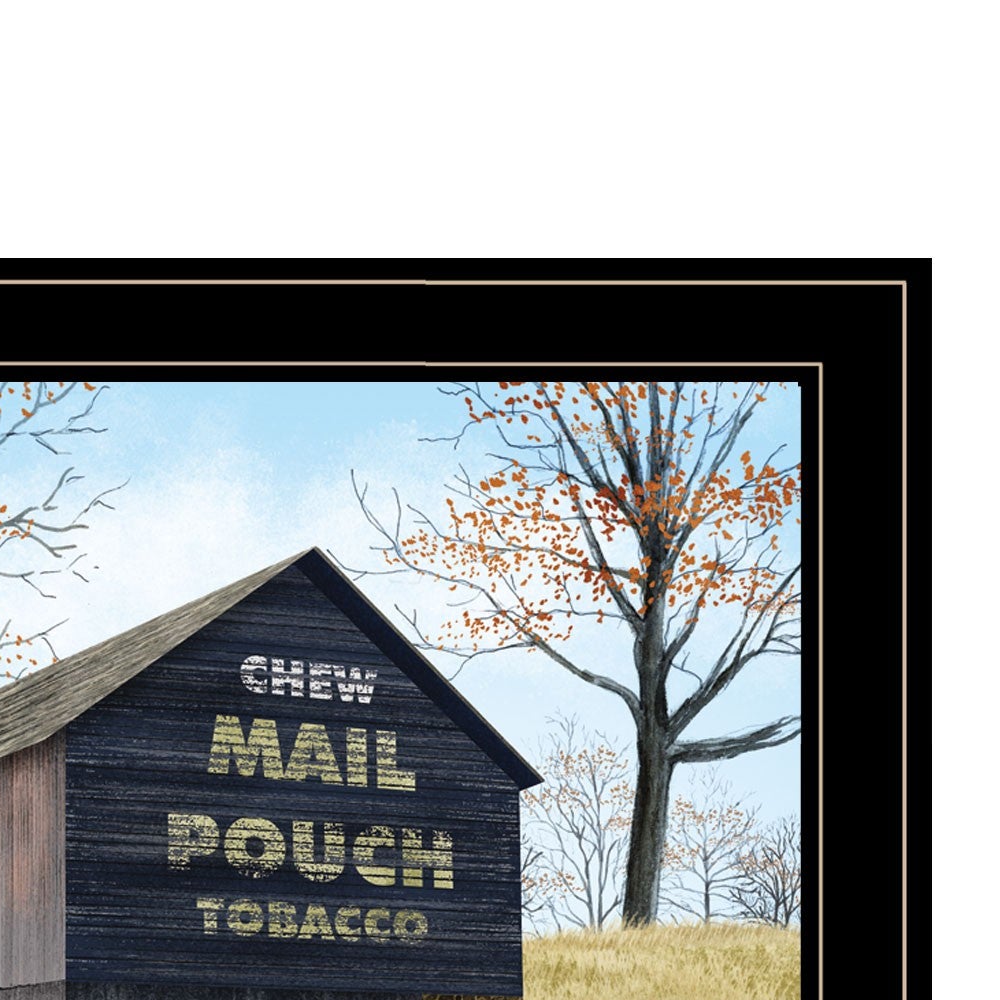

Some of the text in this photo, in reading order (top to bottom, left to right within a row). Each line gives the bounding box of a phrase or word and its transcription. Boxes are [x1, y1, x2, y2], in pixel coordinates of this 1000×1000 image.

[240, 654, 378, 704] CHEW
[207, 713, 416, 791] MAIL
[167, 812, 454, 889] POUCH
[196, 897, 428, 944] TOBACCO
